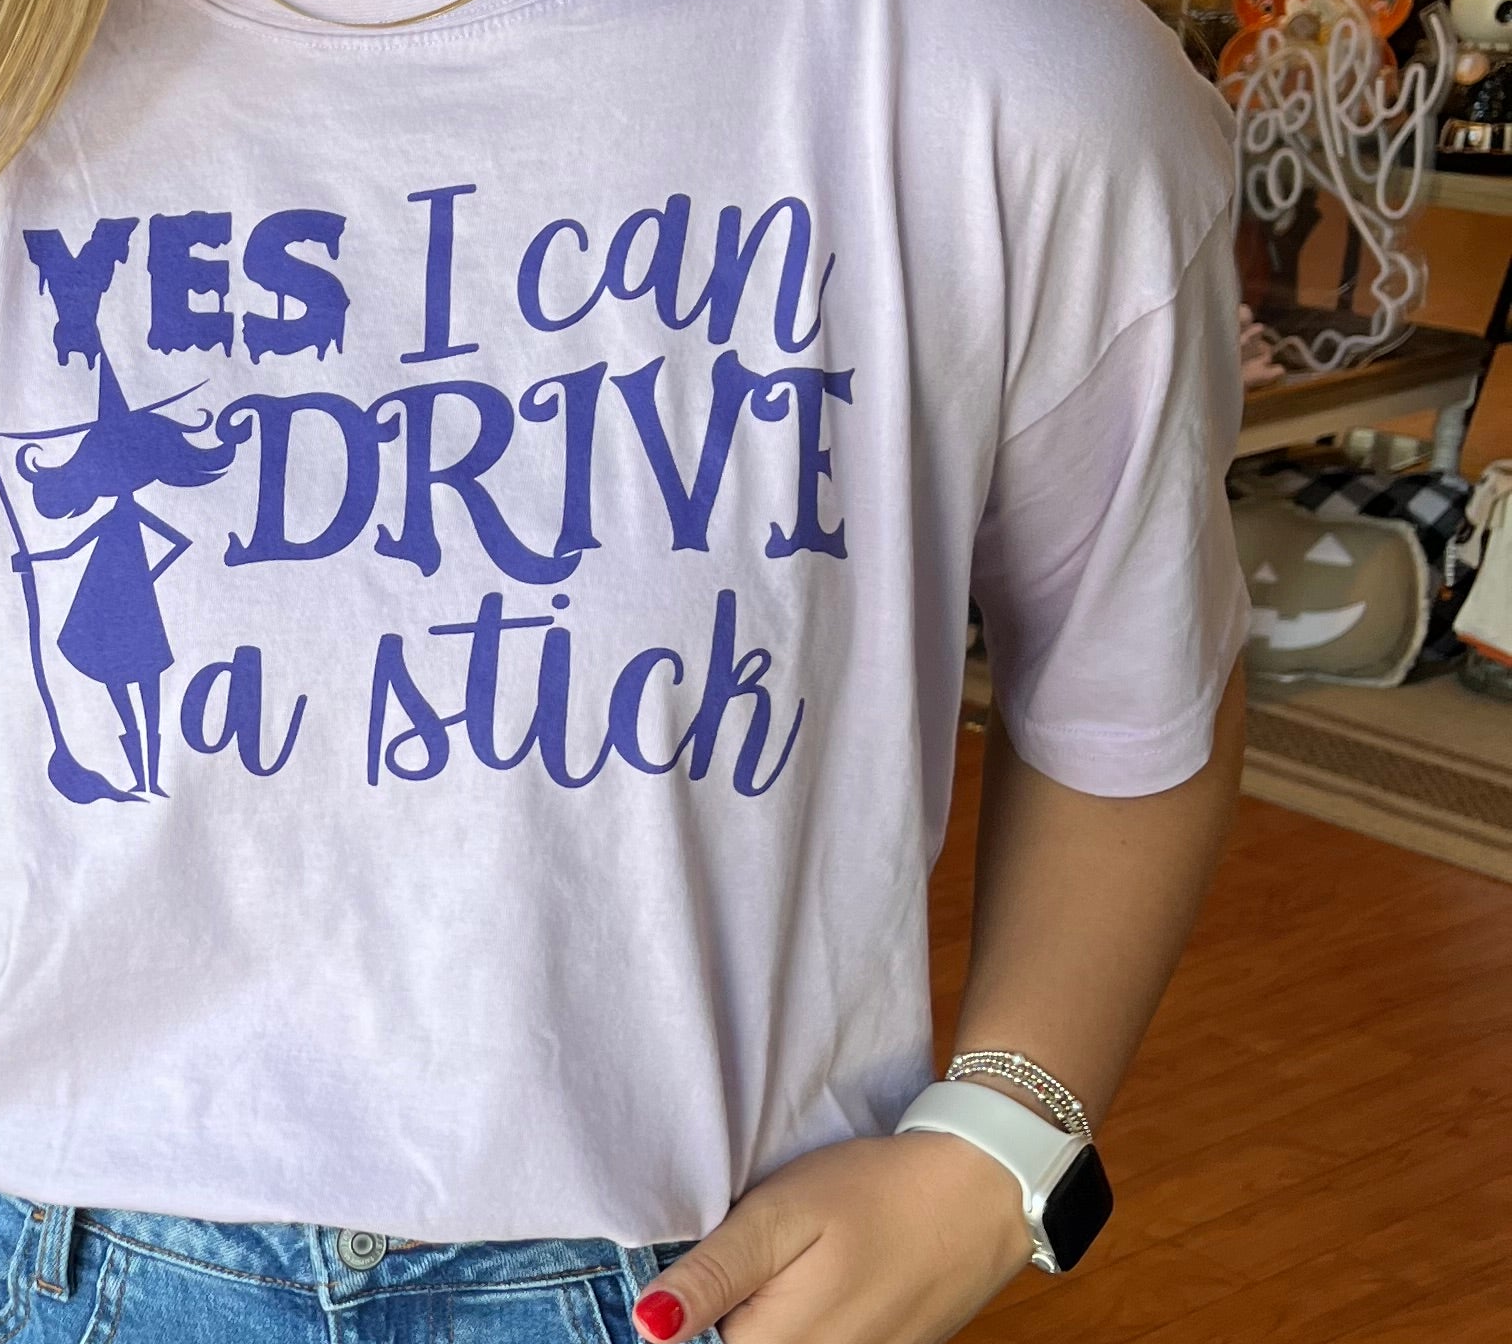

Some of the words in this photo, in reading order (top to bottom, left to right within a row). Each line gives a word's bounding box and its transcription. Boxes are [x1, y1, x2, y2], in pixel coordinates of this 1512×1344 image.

[22, 208, 350, 366] YES
[400, 184, 478, 363] I
[516, 193, 836, 351] can
[215, 349, 854, 584] DRIVE
[179, 645, 307, 777] a
[367, 589, 804, 798] stick
